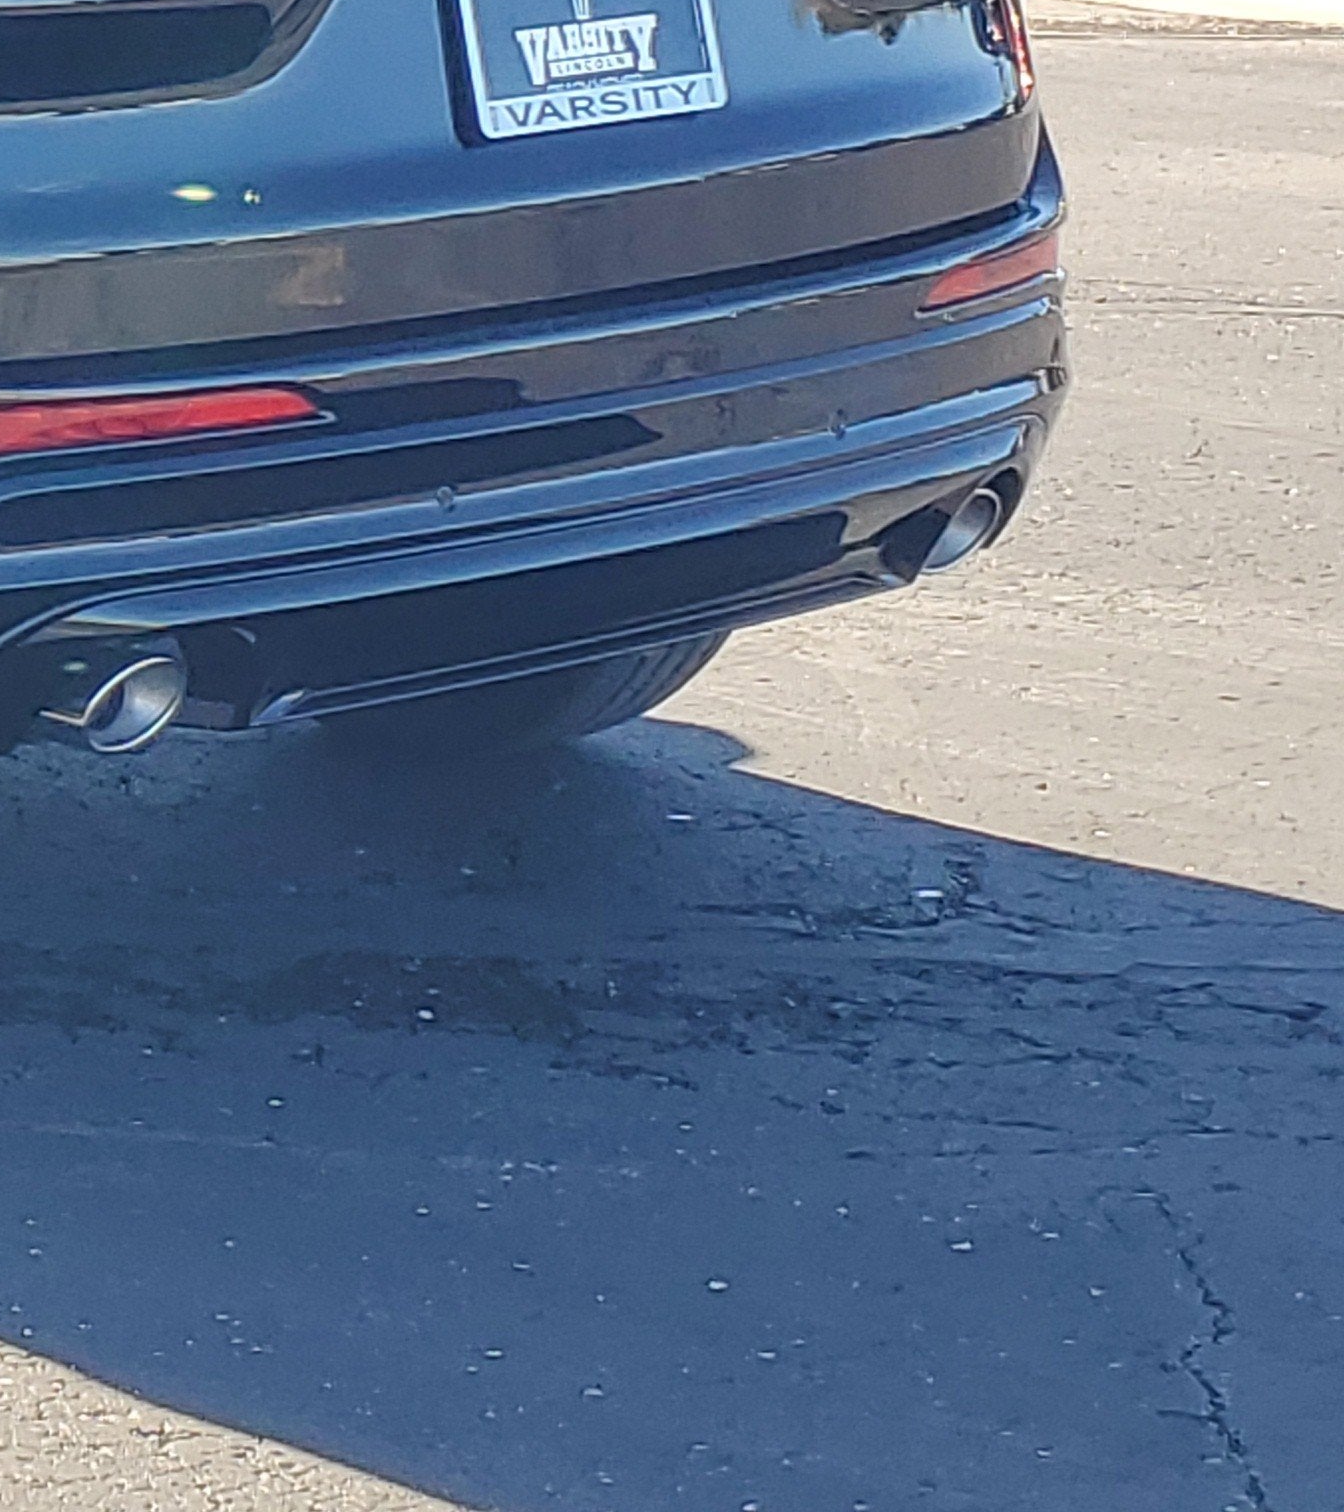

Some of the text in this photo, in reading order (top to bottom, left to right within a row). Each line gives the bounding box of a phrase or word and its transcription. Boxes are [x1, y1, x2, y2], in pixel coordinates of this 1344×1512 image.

[514, 13, 658, 86] VARSITY
[555, 55, 627, 74] LINCOLN
[505, 80, 698, 127] VARSITY
